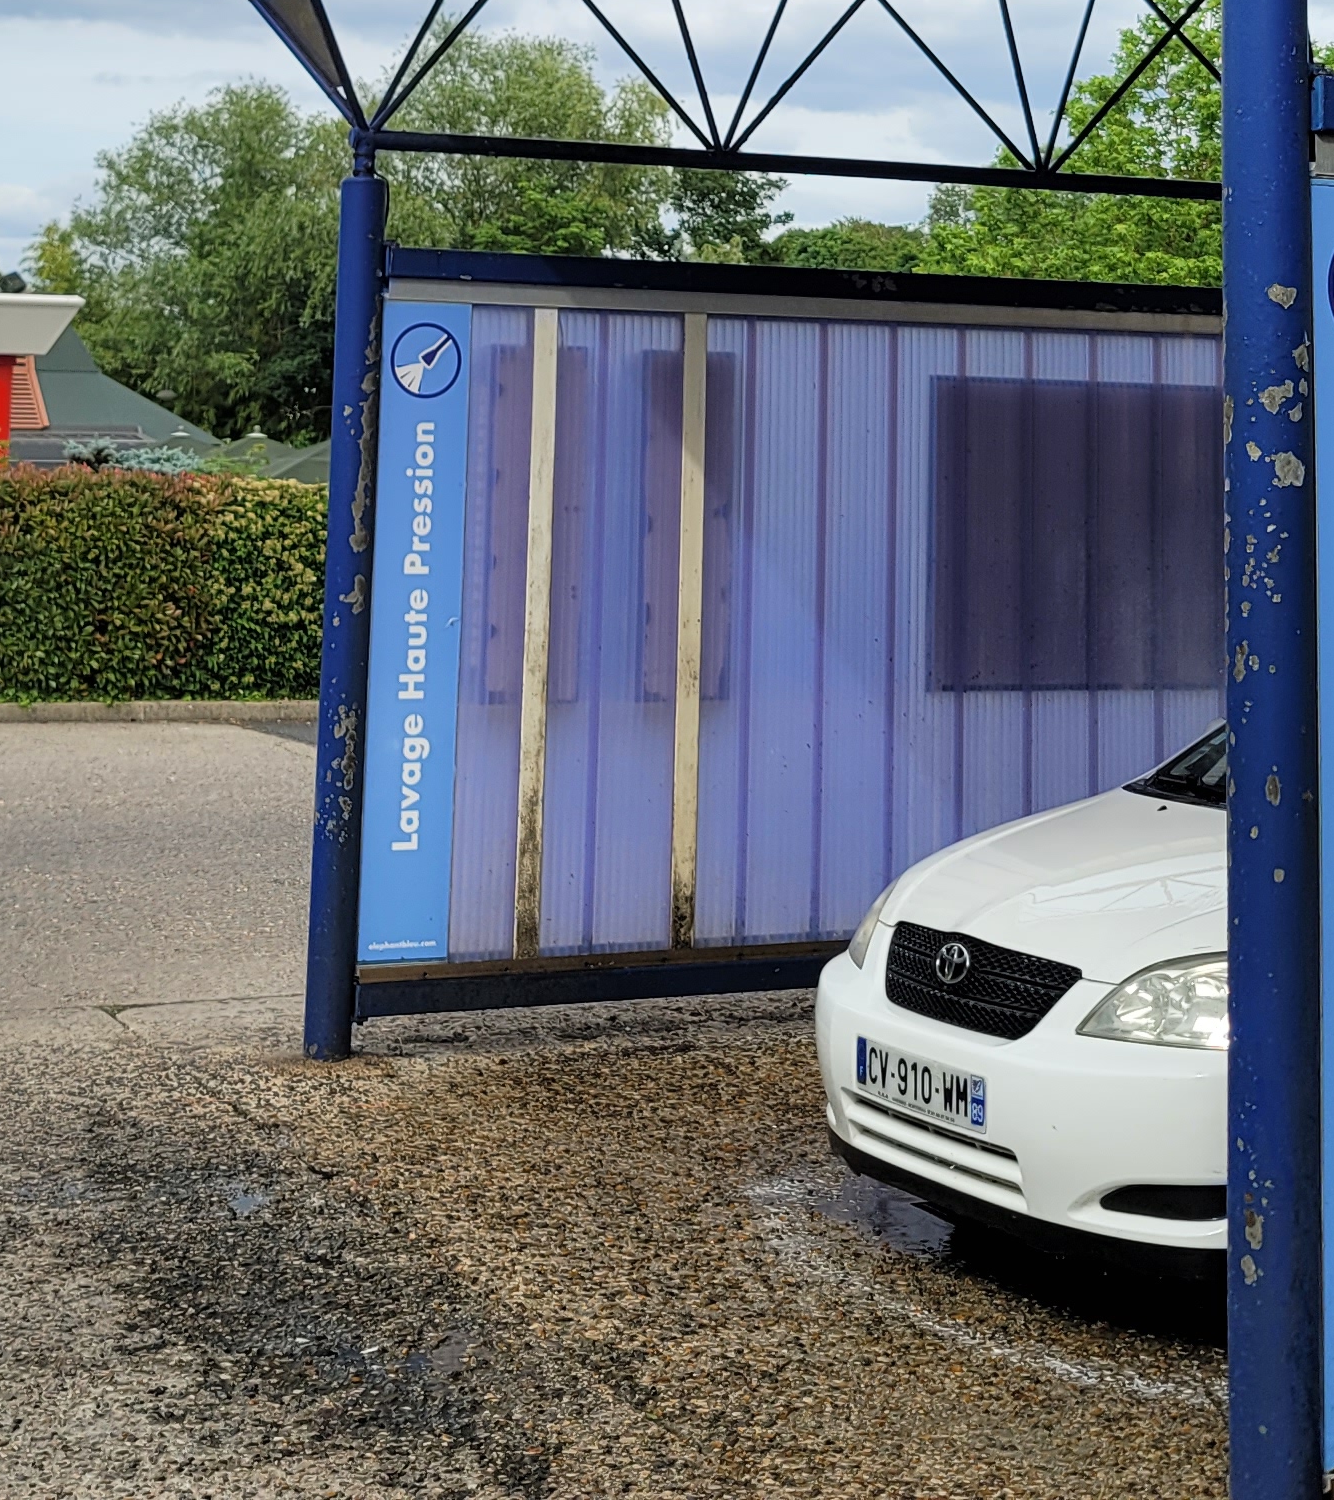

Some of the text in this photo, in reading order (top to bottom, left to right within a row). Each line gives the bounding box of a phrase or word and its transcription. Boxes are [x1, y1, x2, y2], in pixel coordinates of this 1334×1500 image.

[391, 420, 436, 852] Lavage Haute Pression
[868, 1046, 969, 1118] CV-910-WM
[971, 1102, 984, 1123] 89
